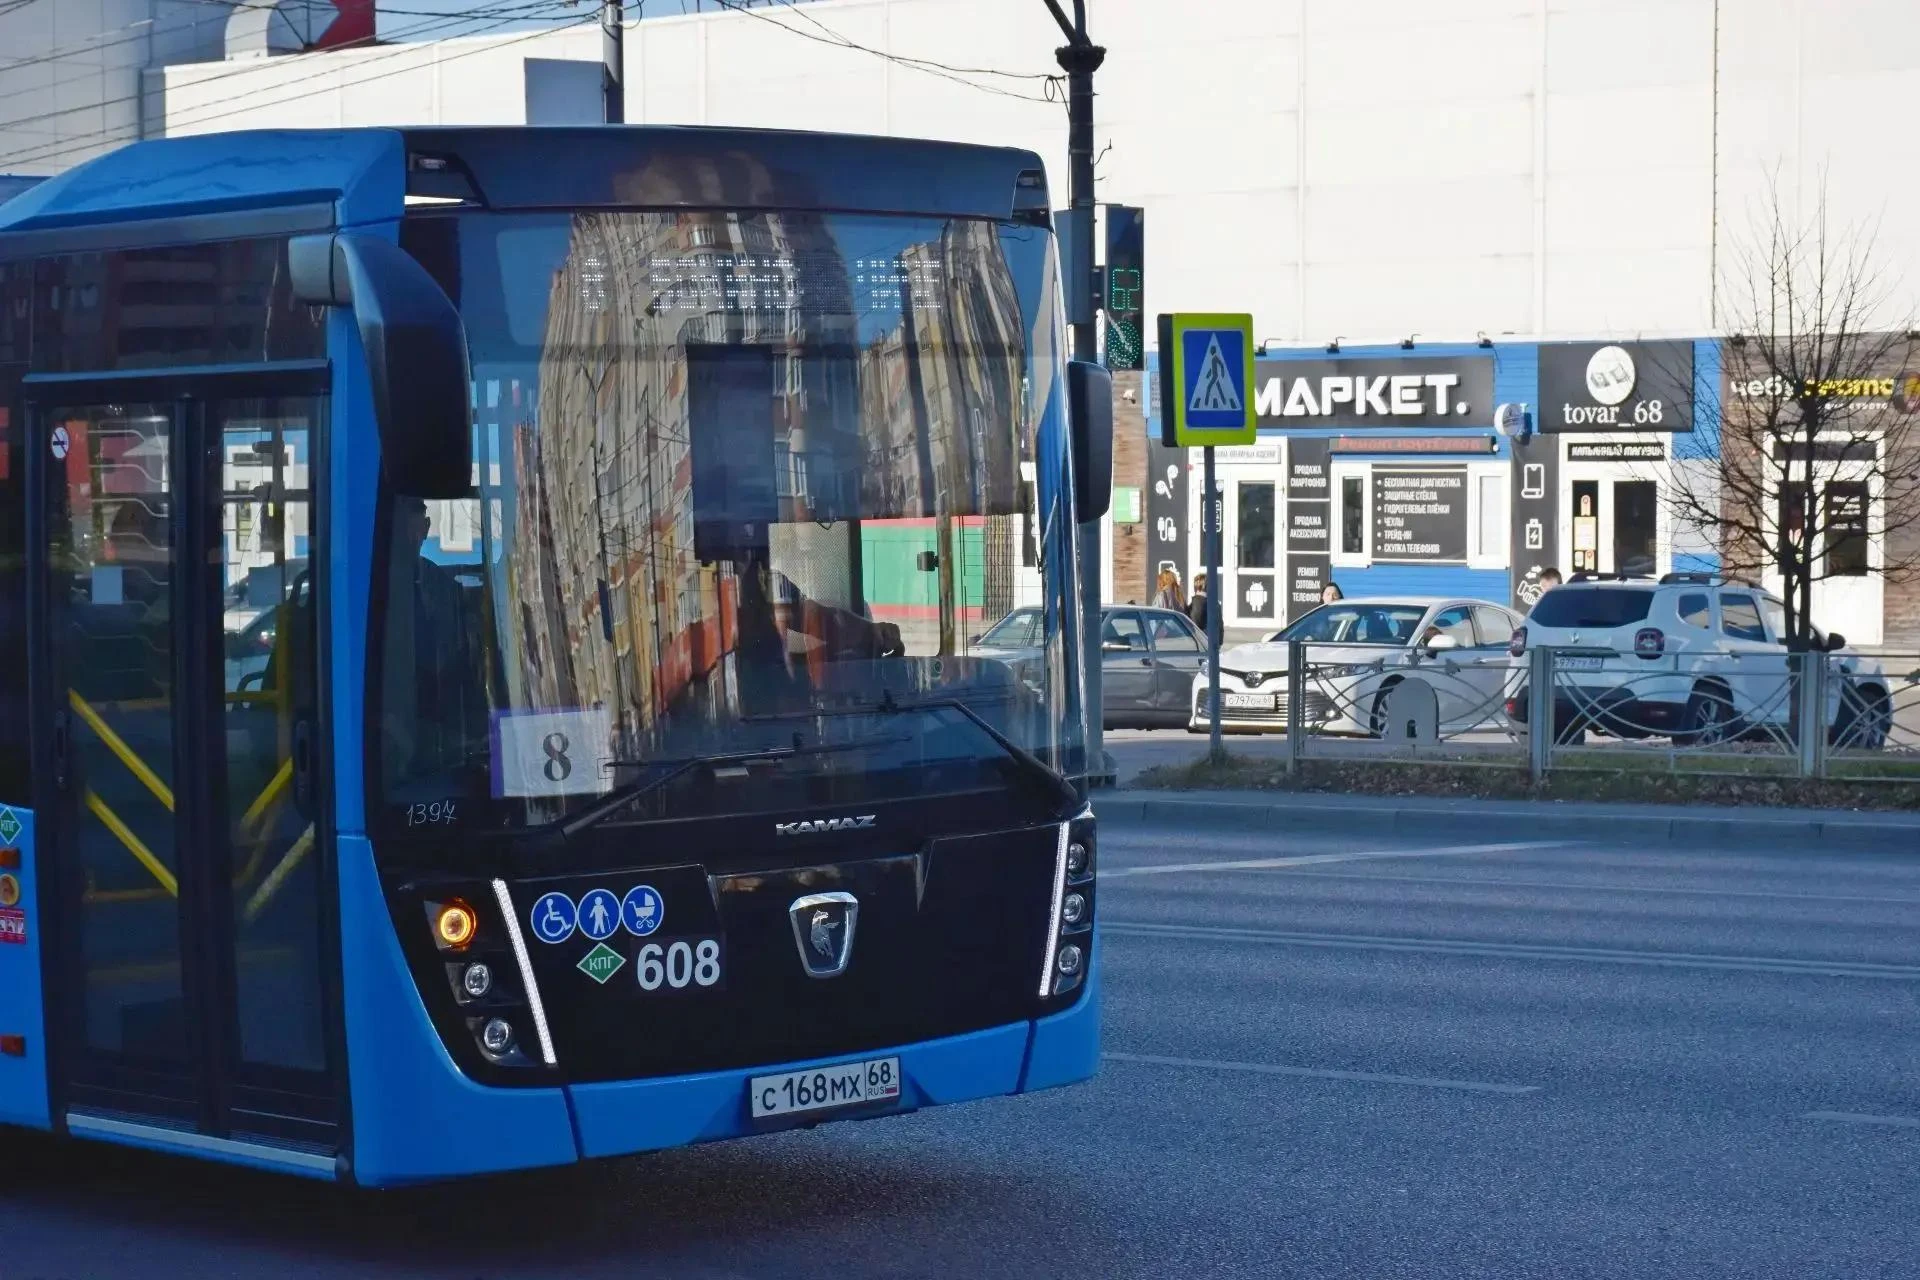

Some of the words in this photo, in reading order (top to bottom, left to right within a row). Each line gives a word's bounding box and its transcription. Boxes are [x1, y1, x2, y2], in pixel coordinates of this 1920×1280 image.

[1294, 465, 1322, 475] ПРОДАЖА
[1294, 516, 1322, 526] ПРОДАЖА
[1297, 567, 1319, 577] РЕМОНТ
[1292, 592, 1321, 602] ТЕЛЕФОНО
[542, 731, 572, 782] 8
[775, 814, 877, 836] KAMAZ
[589, 955, 615, 971] КПГ
[637, 940, 720, 990] 608
[867, 1061, 892, 1087] 68
[867, 1085, 886, 1097] RUS
